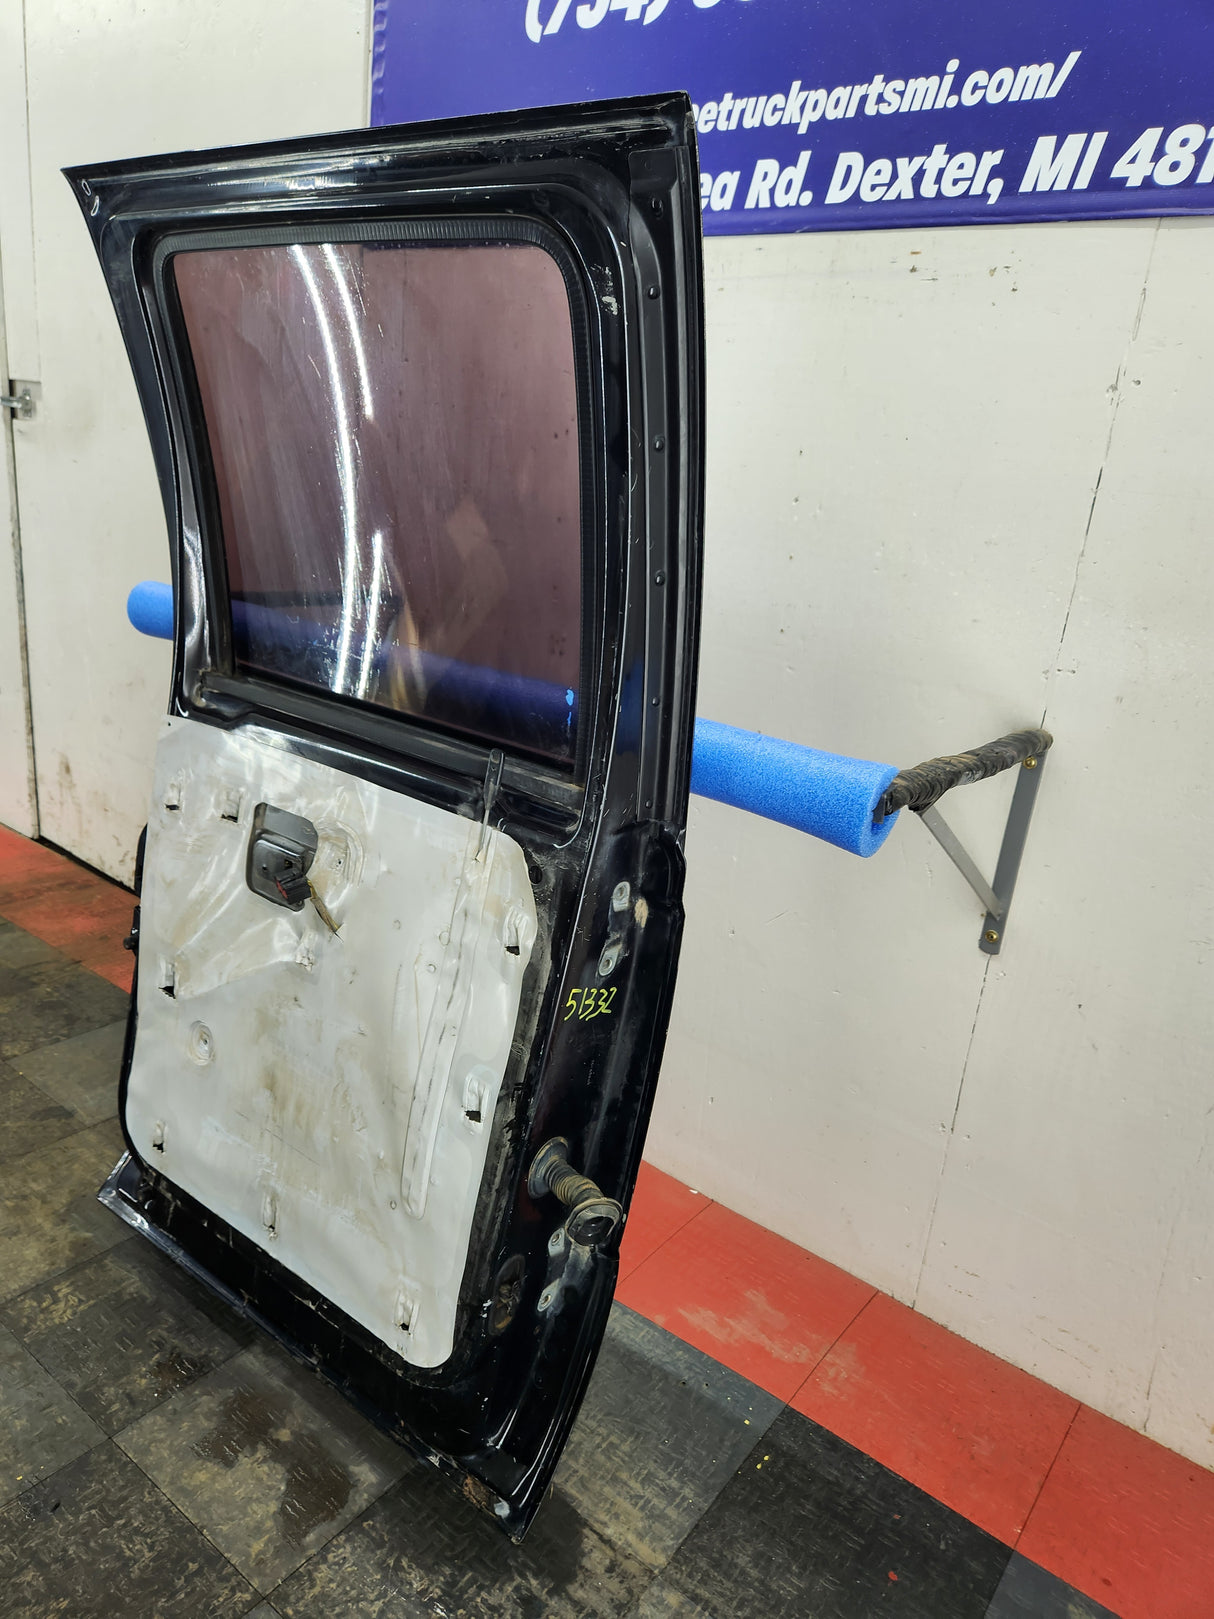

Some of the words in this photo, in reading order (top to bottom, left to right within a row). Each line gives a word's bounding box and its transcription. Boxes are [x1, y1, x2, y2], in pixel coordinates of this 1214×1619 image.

[692, 51, 1082, 135] etruckpartsmi.com/
[744, 150, 814, 209] Rd.
[824, 144, 1004, 205] Dexter,
[1018, 132, 1109, 193] MI
[564, 987, 618, 1021] 51332
